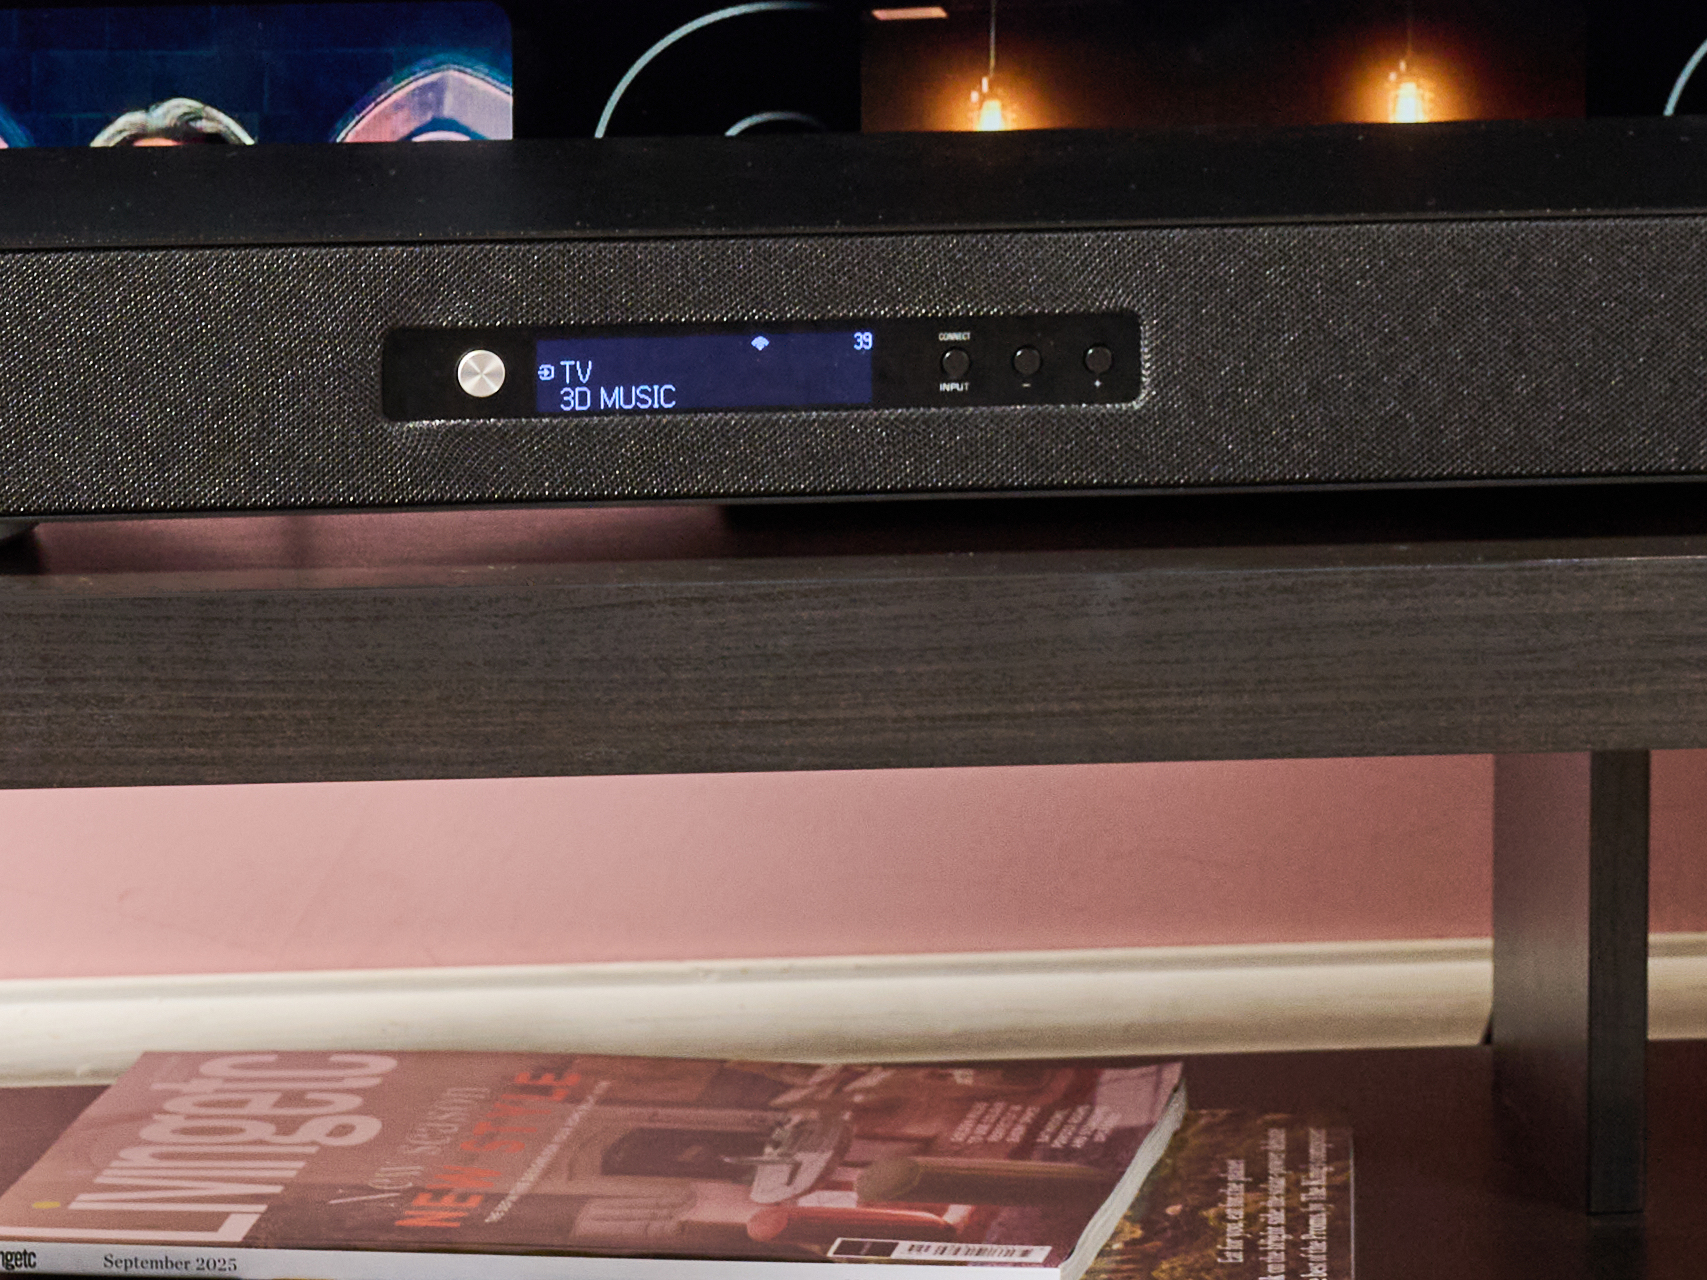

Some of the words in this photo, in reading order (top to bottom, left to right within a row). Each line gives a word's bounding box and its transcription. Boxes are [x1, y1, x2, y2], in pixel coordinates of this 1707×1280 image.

[853, 331, 873, 351] 39
[938, 331, 971, 342] CONNECT
[559, 360, 592, 384] TV
[939, 382, 970, 392] INPUT
[560, 387, 591, 411] 3D
[600, 384, 676, 410] MUSIC
[395, 1164, 501, 1228] NEW
[460, 1070, 582, 1155] STYLE
[103, 1253, 192, 1271] September
[195, 1257, 238, 1271] 2025
